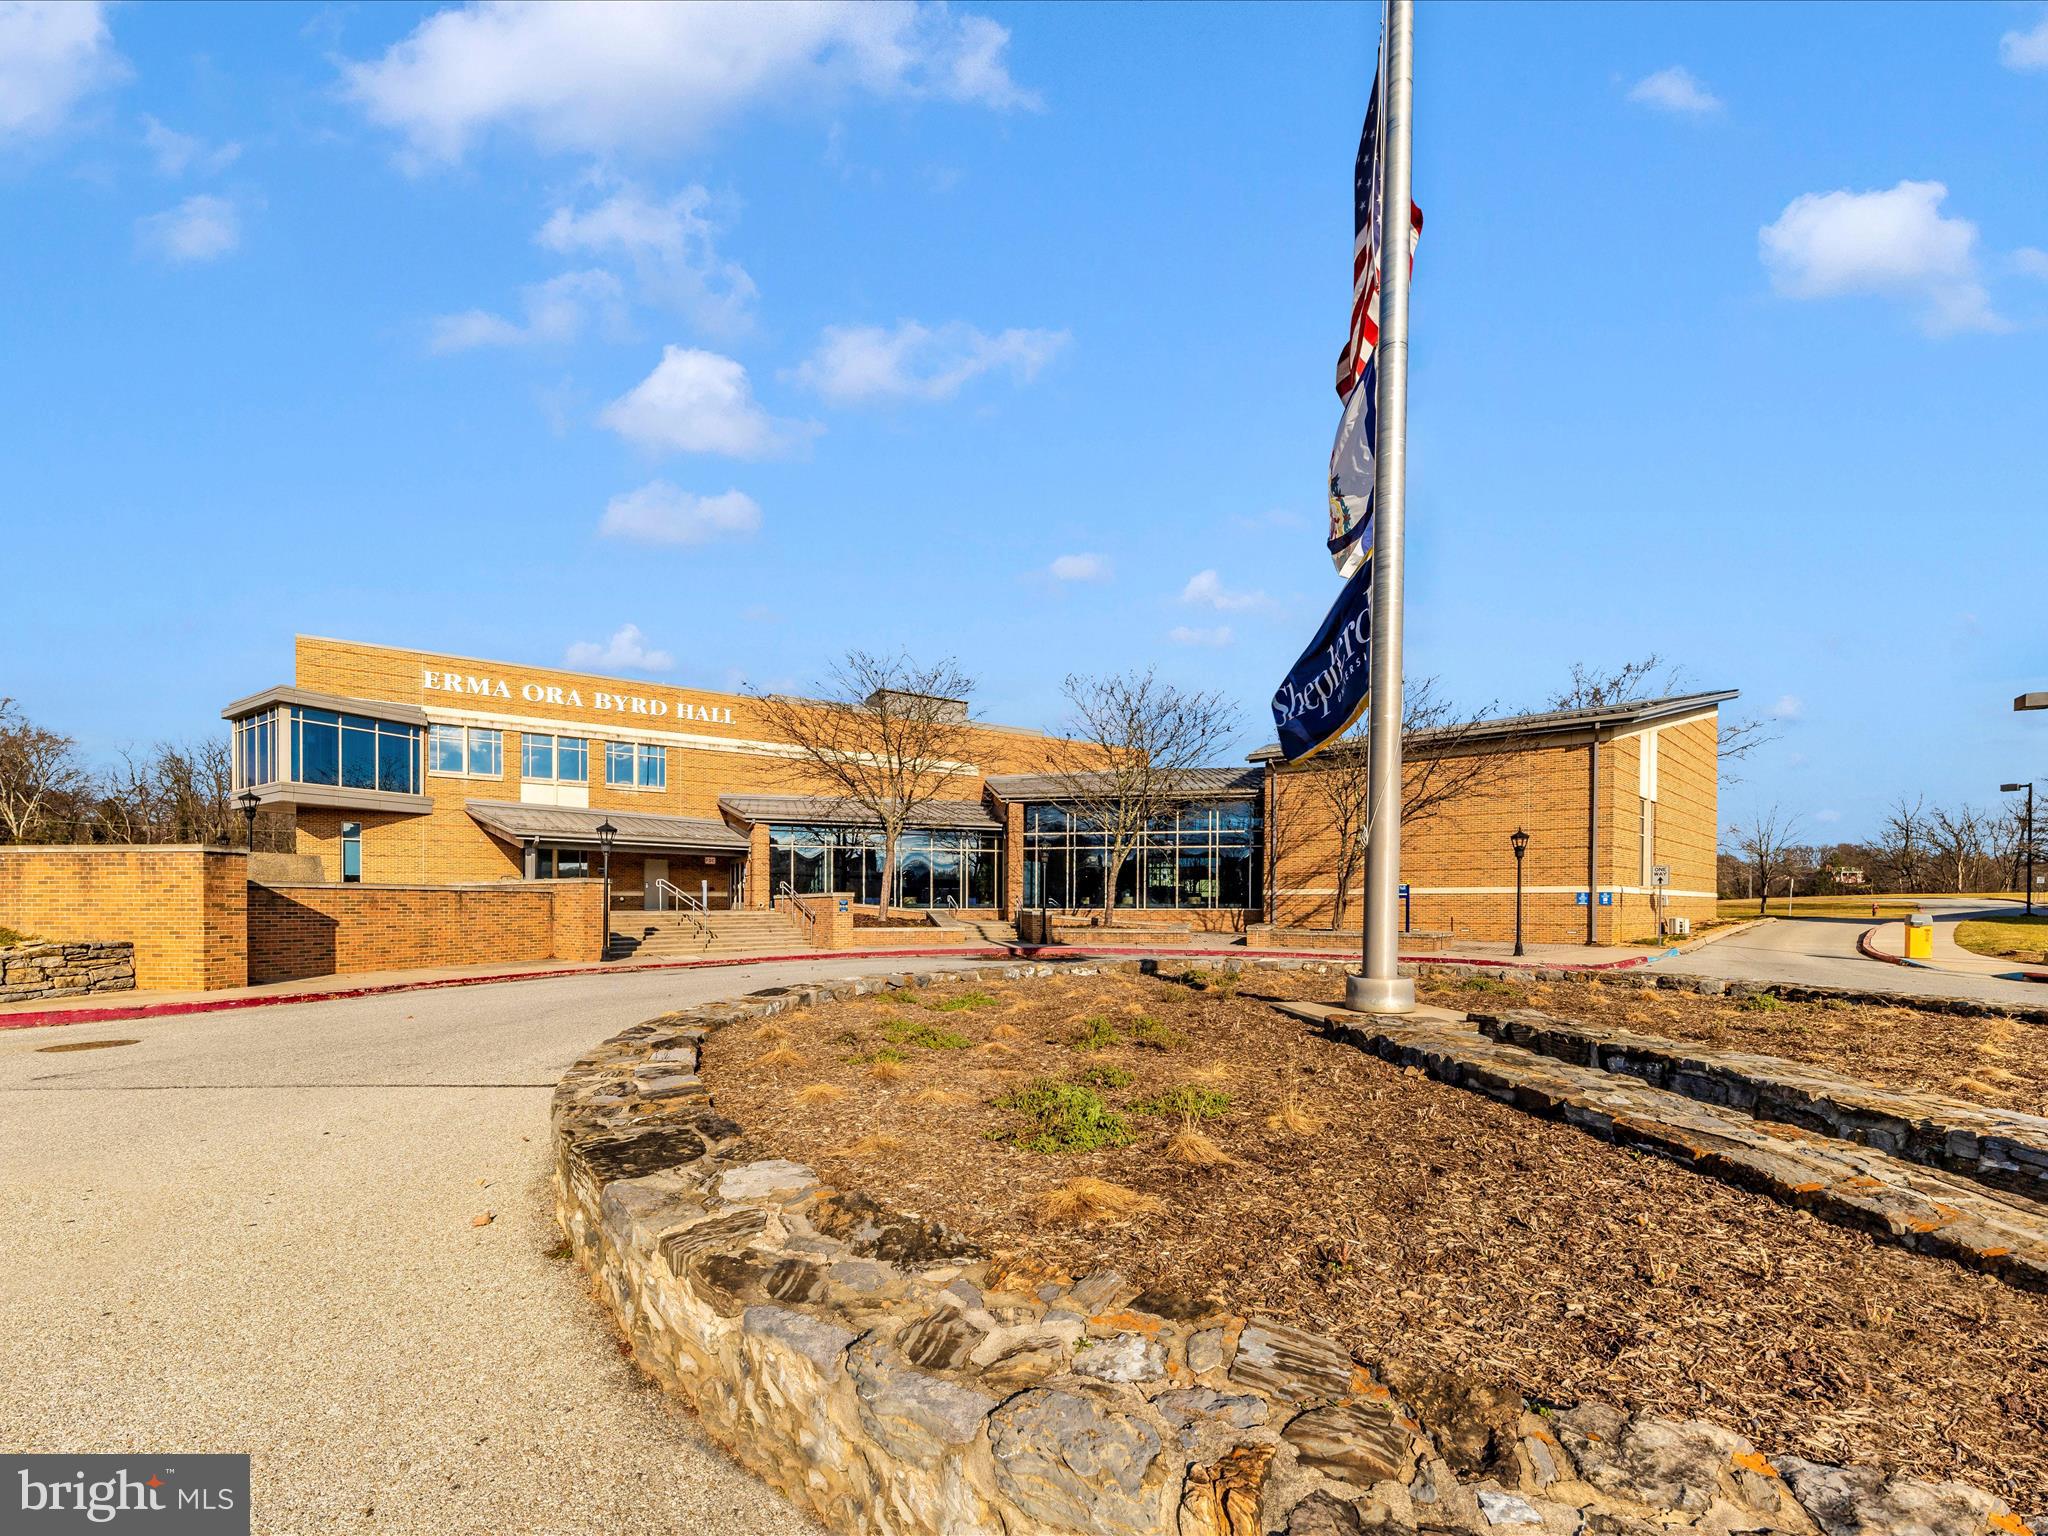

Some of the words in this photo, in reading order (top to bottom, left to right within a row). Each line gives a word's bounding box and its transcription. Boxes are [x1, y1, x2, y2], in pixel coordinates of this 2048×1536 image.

[423, 670, 512, 699] ERMA
[522, 684, 584, 708] ORA
[594, 691, 668, 717] BYRD
[677, 702, 737, 725] HALL
[1337, 652, 1367, 703] UNERSI
